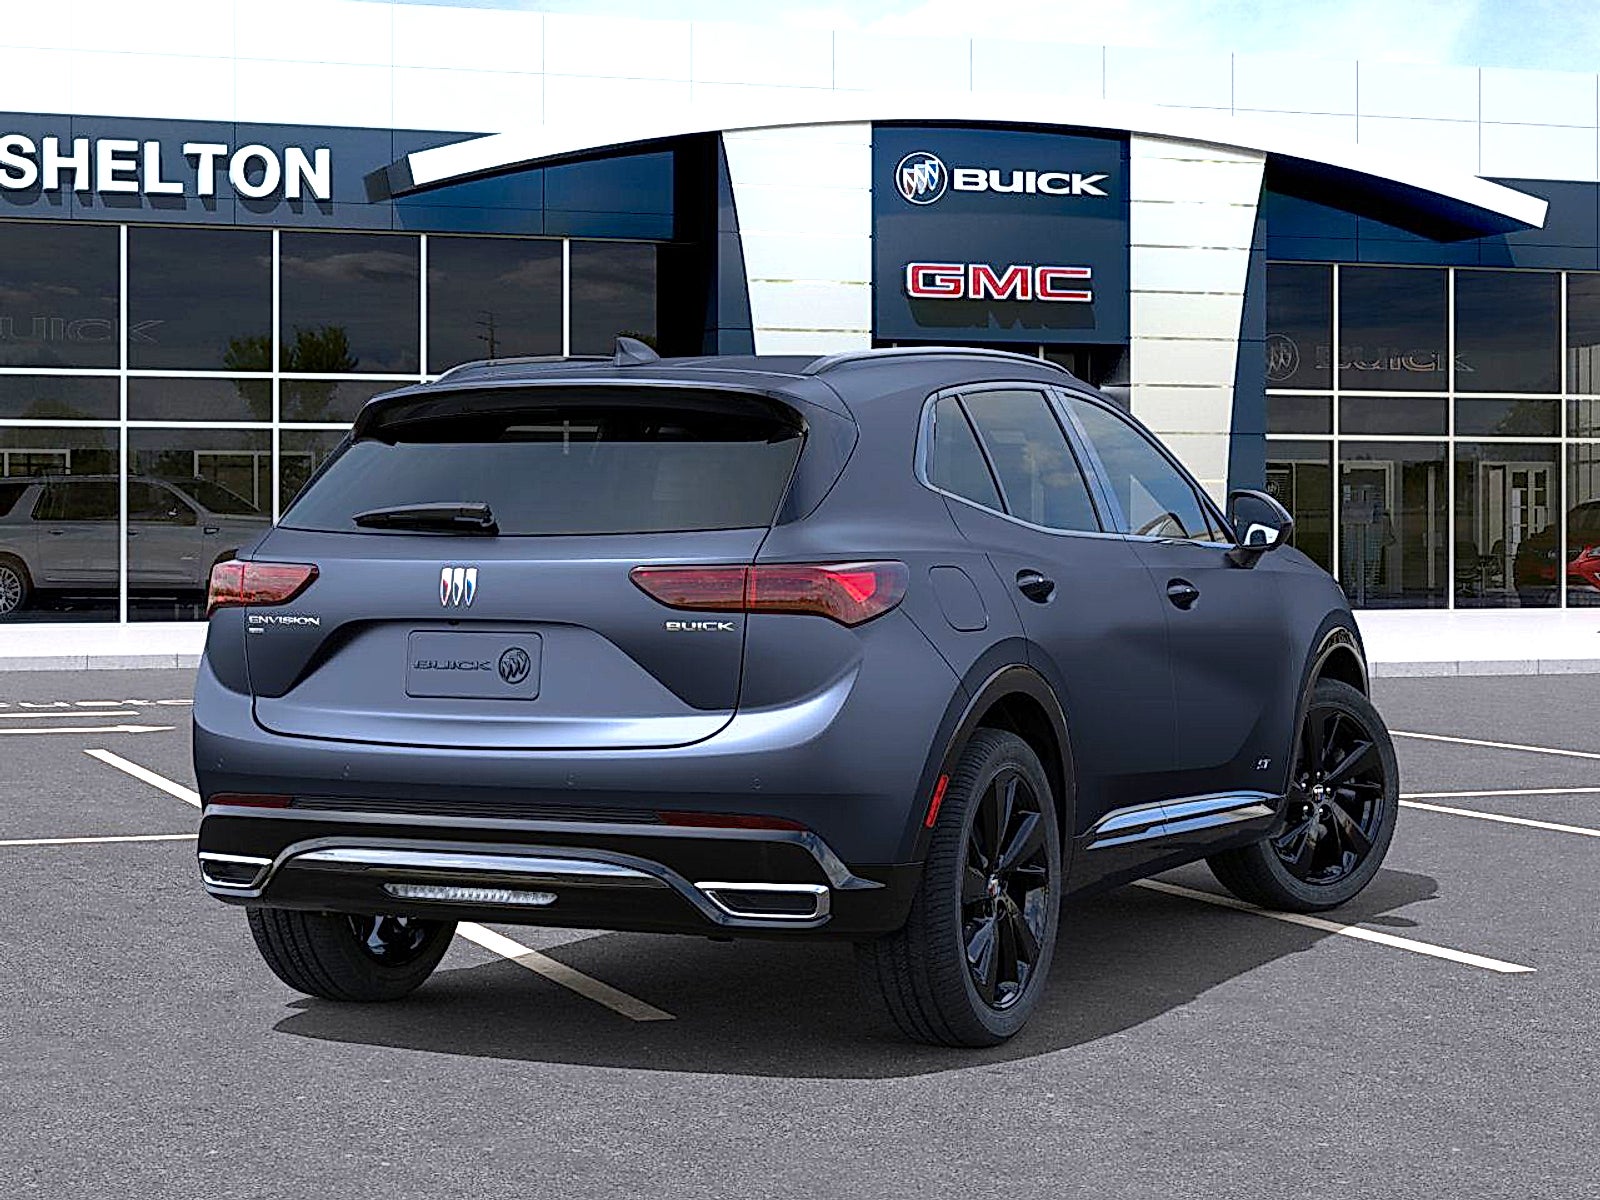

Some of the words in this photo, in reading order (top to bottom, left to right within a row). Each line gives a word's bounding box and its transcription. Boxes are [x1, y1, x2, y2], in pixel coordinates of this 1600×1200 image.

[0, 134, 331, 200] SHELTON
[953, 168, 1109, 196] BUICK
[906, 261, 1092, 302] GMC
[248, 615, 320, 627] ENVISION
[665, 621, 736, 632] BUICK
[412, 659, 492, 671] BUICK
